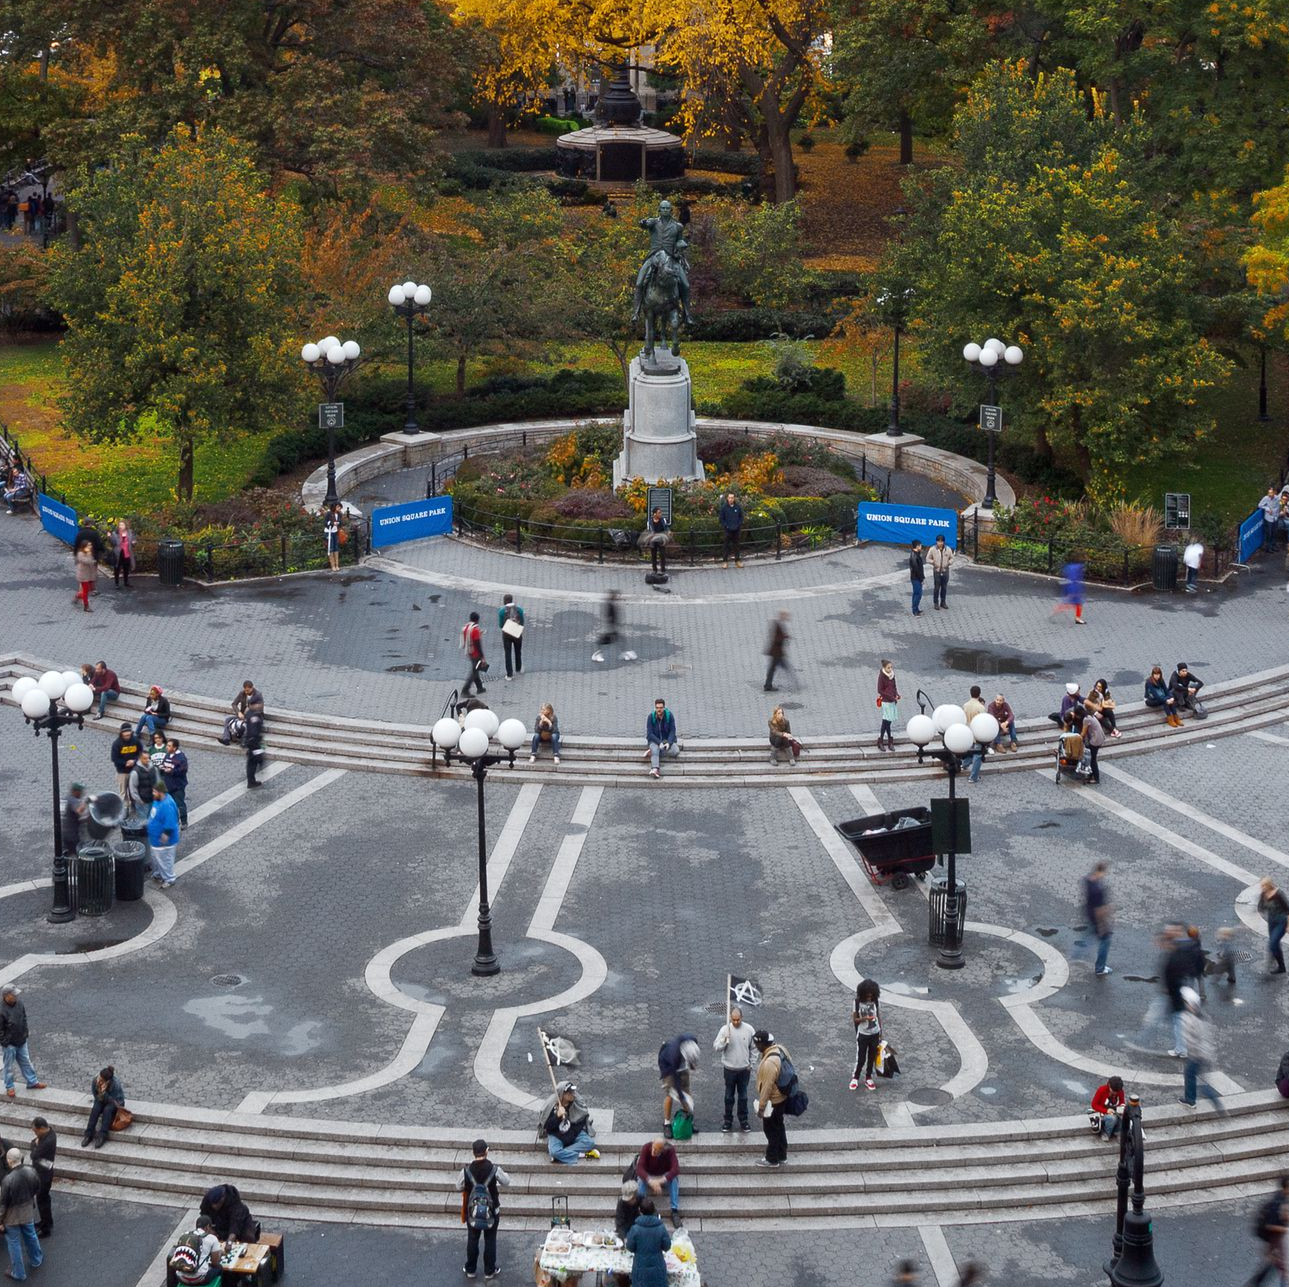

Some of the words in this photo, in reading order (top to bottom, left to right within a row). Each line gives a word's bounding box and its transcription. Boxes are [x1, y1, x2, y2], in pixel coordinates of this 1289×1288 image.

[379, 515, 401, 526] UNION
[401, 510, 428, 522] SQUARE
[428, 507, 446, 517] PARK
[866, 513, 893, 523] UNION
[893, 516, 927, 526] SQUARE
[928, 519, 950, 528] PARK
